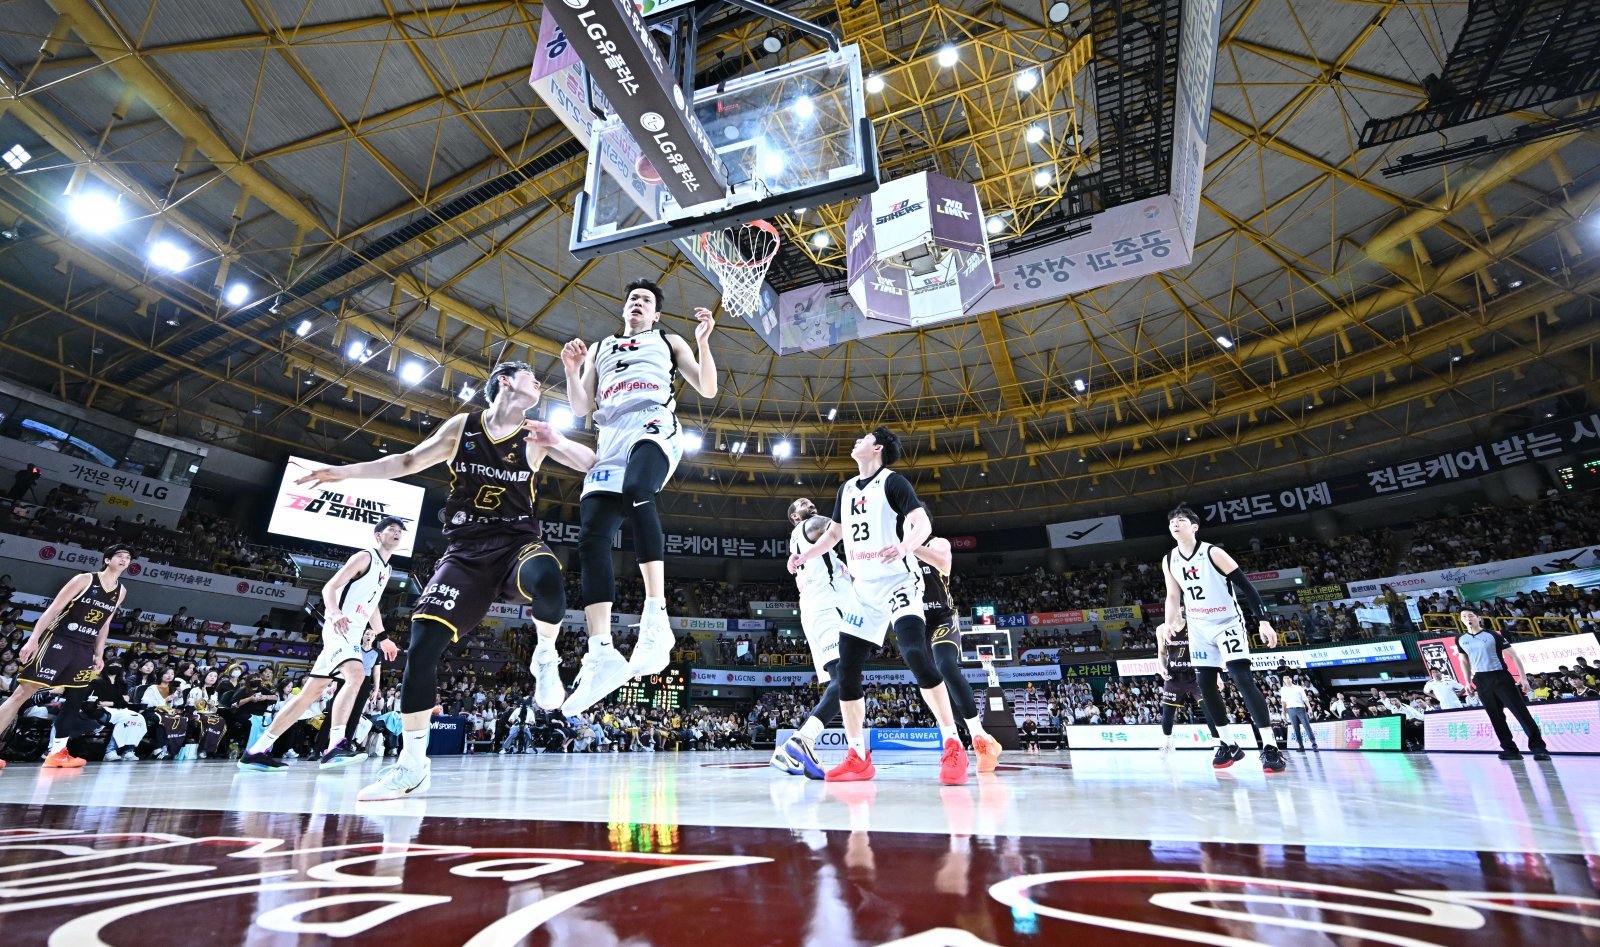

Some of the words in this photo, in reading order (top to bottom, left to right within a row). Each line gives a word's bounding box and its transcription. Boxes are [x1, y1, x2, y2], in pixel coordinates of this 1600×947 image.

[577, 10, 642, 97] LG유플러스
[653, 131, 700, 193] LG유플러스
[610, 339, 641, 354] kt
[456, 462, 467, 472] LG
[1367, 445, 1490, 494] 전문케어
[1493, 430, 1564, 468] 받는
[70, 464, 110, 486] 가전은
[113, 474, 140, 494] 역시
[142, 483, 168, 500] LG
[318, 488, 344, 503] NO
[346, 496, 392, 513] LIMIT
[851, 496, 868, 516] kt
[1203, 494, 1276, 524] 가전도
[1279, 482, 1332, 512] 이제
[852, 522, 870, 542] 23
[722, 538, 756, 558] 받는
[1182, 566, 1200, 580] kt
[1187, 586, 1206, 600] 12
[1222, 638, 1243, 654] 12
[1078, 664, 1112, 676] 라쉬반
